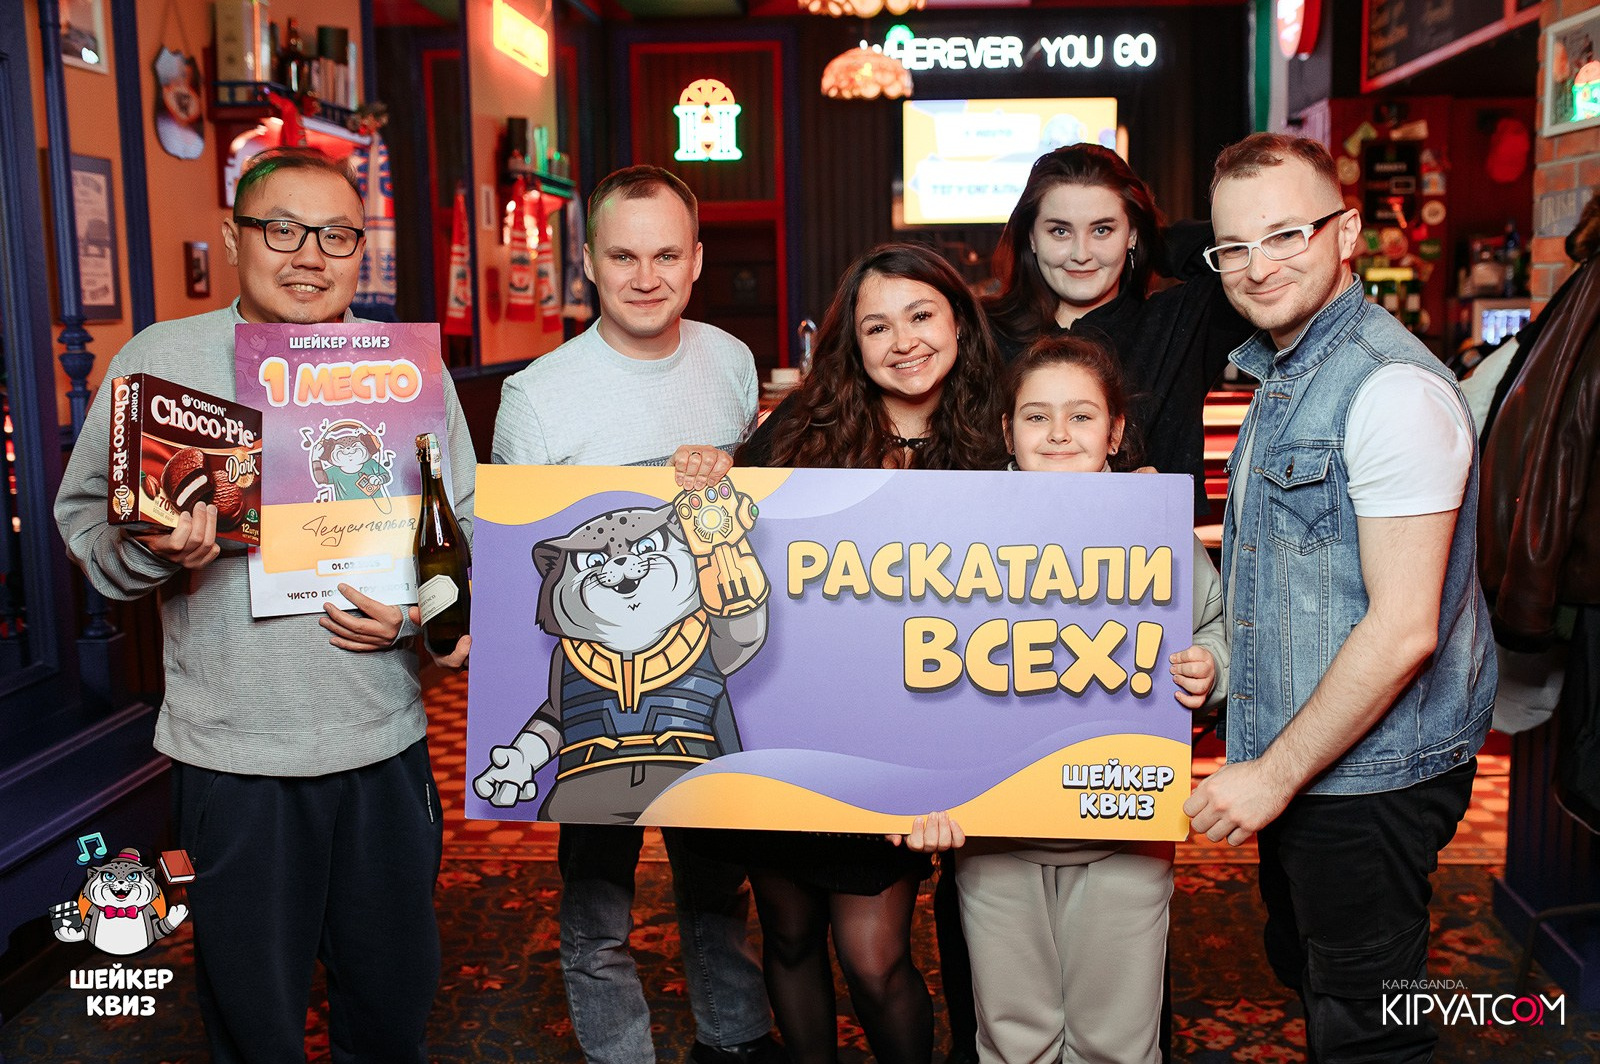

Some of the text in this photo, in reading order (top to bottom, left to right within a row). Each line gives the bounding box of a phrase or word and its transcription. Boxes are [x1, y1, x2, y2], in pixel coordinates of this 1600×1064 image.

[1041, 34, 1103, 67] YOU
[1113, 32, 1157, 67] GO
[289, 334, 390, 349] ШЕЙКЕР КВИЗ
[261, 359, 420, 404] 1 МЕСТО
[130, 393, 138, 421] ORION
[193, 399, 225, 417] ORION
[226, 455, 260, 482] Dark
[114, 485, 133, 520] Dark
[787, 540, 1174, 605] РАСКАТАЛИ
[287, 591, 318, 600] ЧИСТО
[903, 616, 1163, 698] ВСЕХ!
[1062, 758, 1174, 792] ШЕЙКЕР
[1080, 792, 1155, 820] КВИЗ
